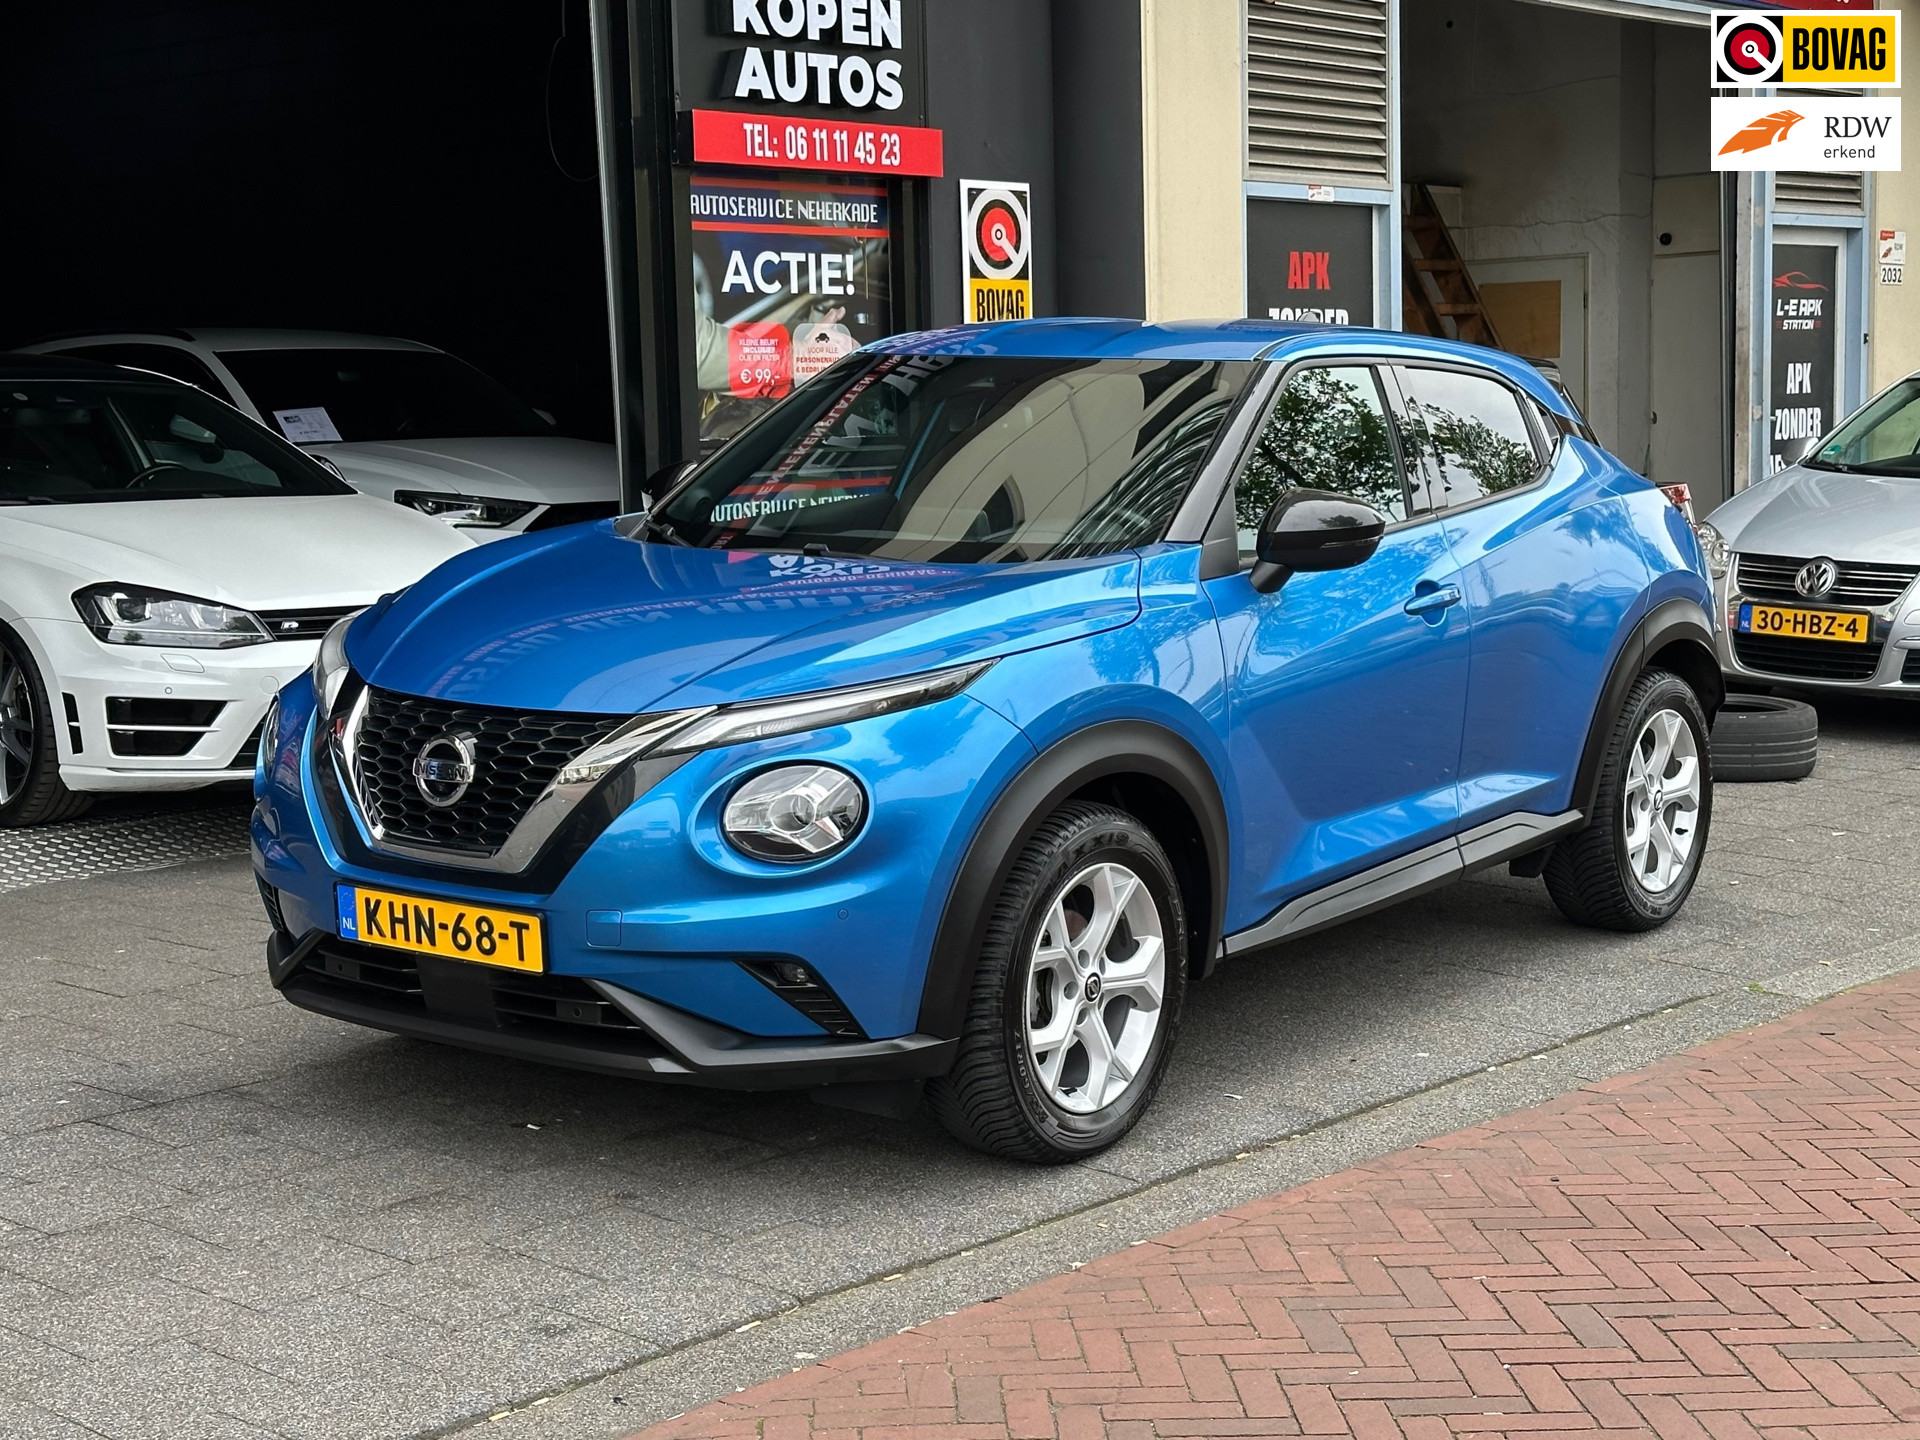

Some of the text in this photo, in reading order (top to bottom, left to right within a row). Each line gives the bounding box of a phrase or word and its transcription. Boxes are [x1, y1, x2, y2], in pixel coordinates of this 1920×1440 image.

[733, 0, 902, 49] KOPEN
[735, 47, 903, 111] AUTOS
[743, 122, 901, 166] TEL: 06 11 11 45 23
[690, 194, 878, 223] AUTOSERVICE NEHERKADE
[721, 251, 855, 295] ACTIE!
[1287, 251, 1331, 290] APK
[1882, 267, 1902, 283] 2032
[976, 288, 1025, 322] BOVAG
[1799, 299, 1822, 317] APK
[1782, 319, 1815, 330] STATION
[807, 346, 825, 354] VOOR
[740, 368, 780, 385] € 99,-
[1786, 363, 1812, 394] APK
[1775, 407, 1821, 440] ZONDER
[1741, 620, 1750, 628] NL
[1757, 610, 1859, 638] 30-HBZ-4
[414, 760, 470, 781] NISSAN
[342, 916, 356, 931] NL
[363, 896, 530, 962] KHN-68-T
